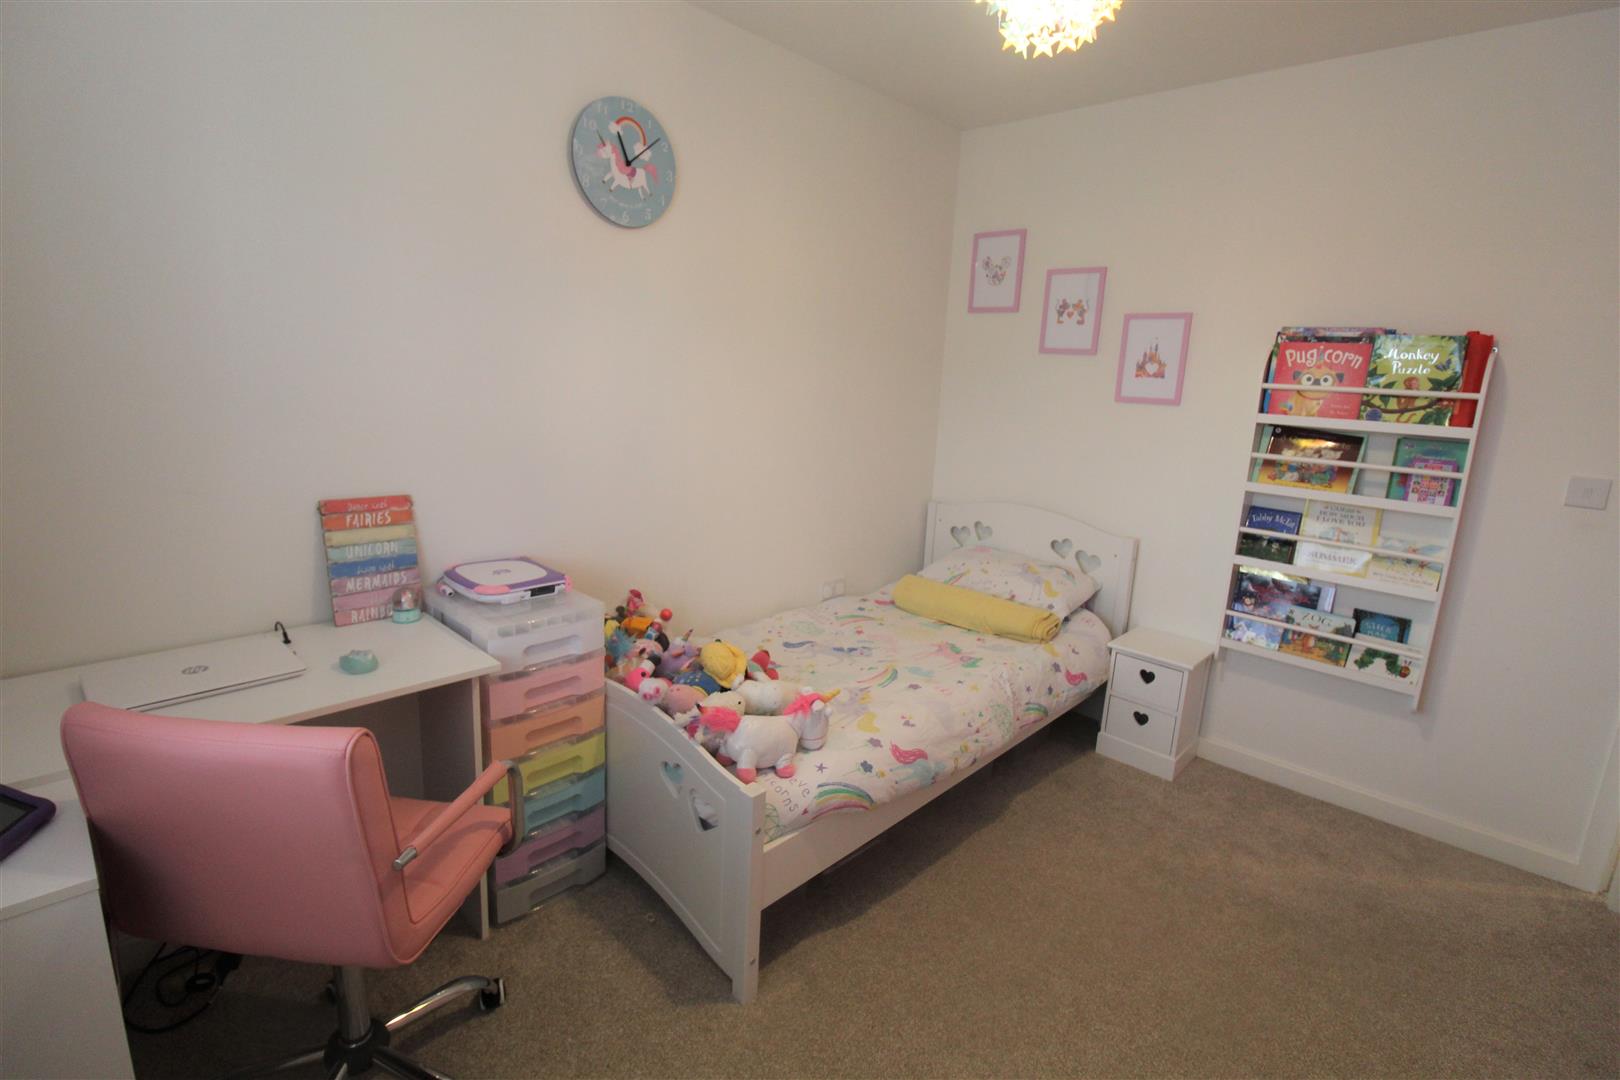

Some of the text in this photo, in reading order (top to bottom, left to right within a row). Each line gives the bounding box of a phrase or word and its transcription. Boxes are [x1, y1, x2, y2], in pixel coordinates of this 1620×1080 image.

[660, 142, 669, 152] 2
[1383, 348, 1440, 364] Monkey
[1391, 360, 1431, 375] Puzzle
[345, 510, 392, 528] FAIRIES
[345, 541, 399, 558] UNICORN
[346, 571, 408, 593] MERMAIDS
[351, 603, 394, 624] RAINBO
[1299, 612, 1333, 627] ZOG
